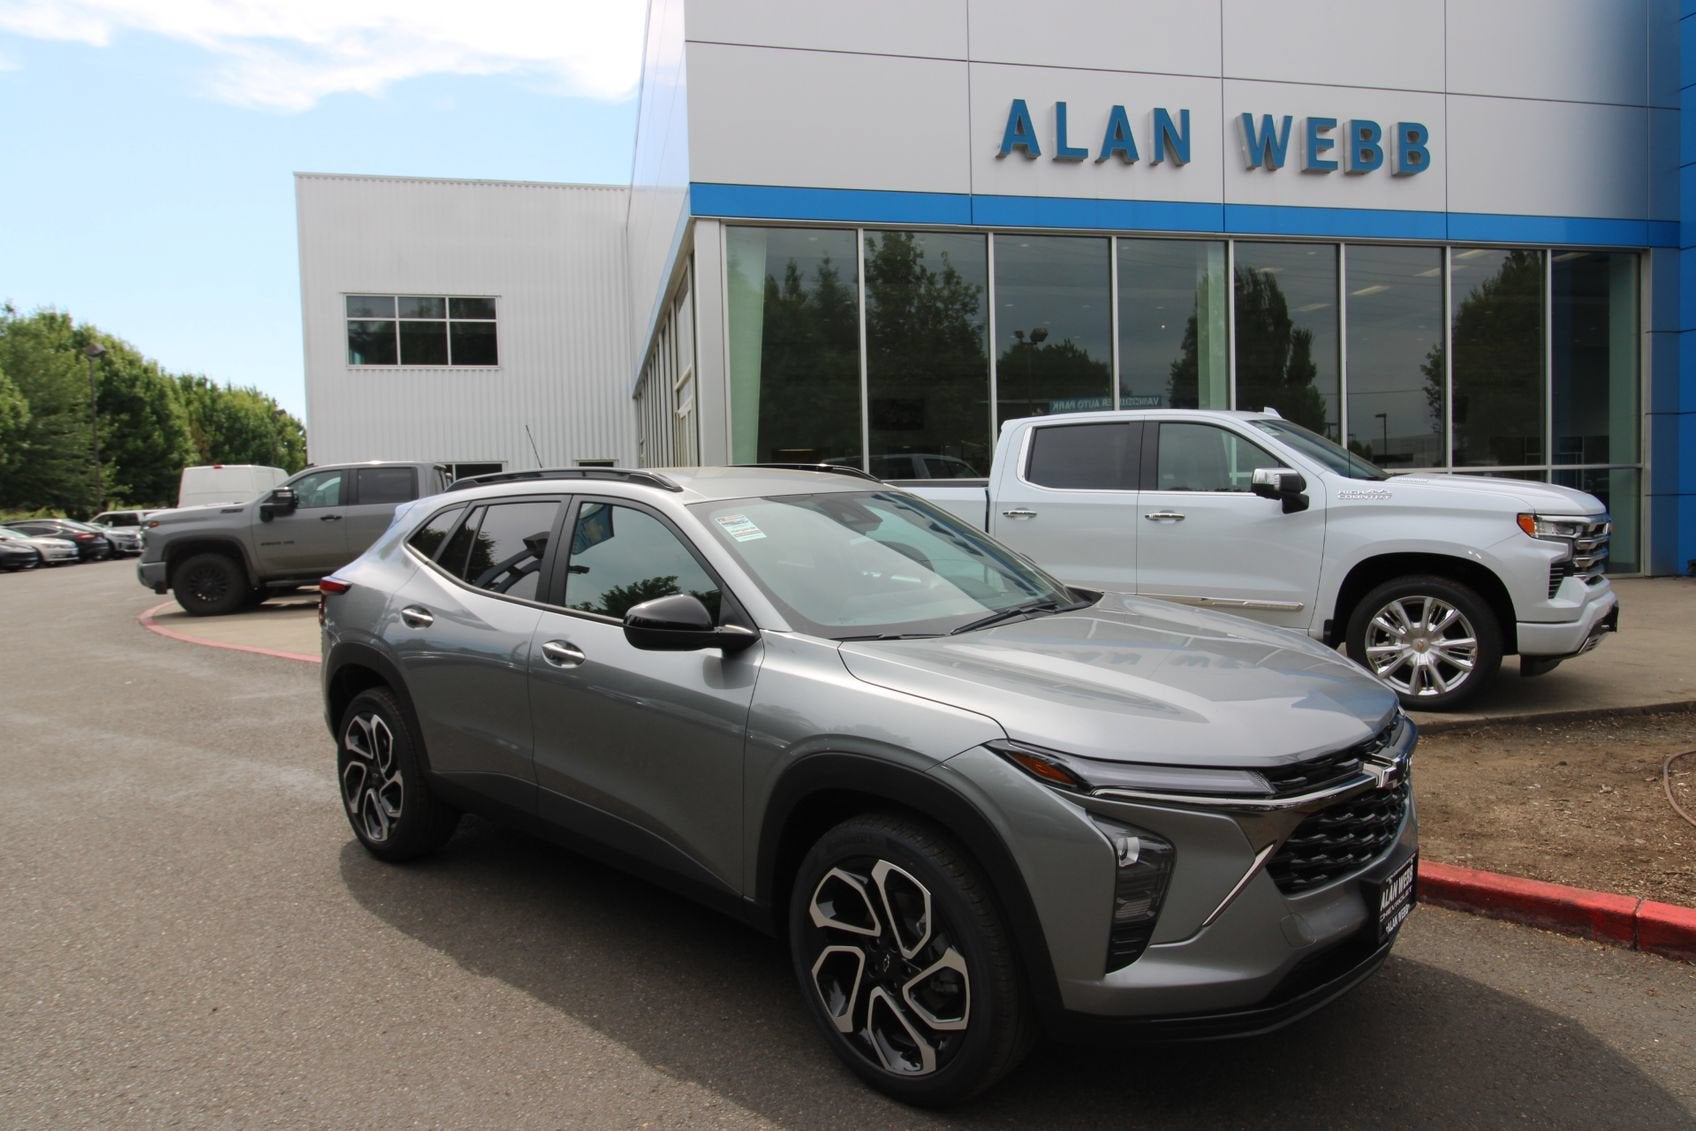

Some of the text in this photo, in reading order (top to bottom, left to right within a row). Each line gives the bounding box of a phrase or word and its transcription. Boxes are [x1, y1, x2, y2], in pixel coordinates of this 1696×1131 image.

[996, 98, 1431, 178] ALAN WEBB
[1380, 864, 1414, 912] ALAN WEBB
